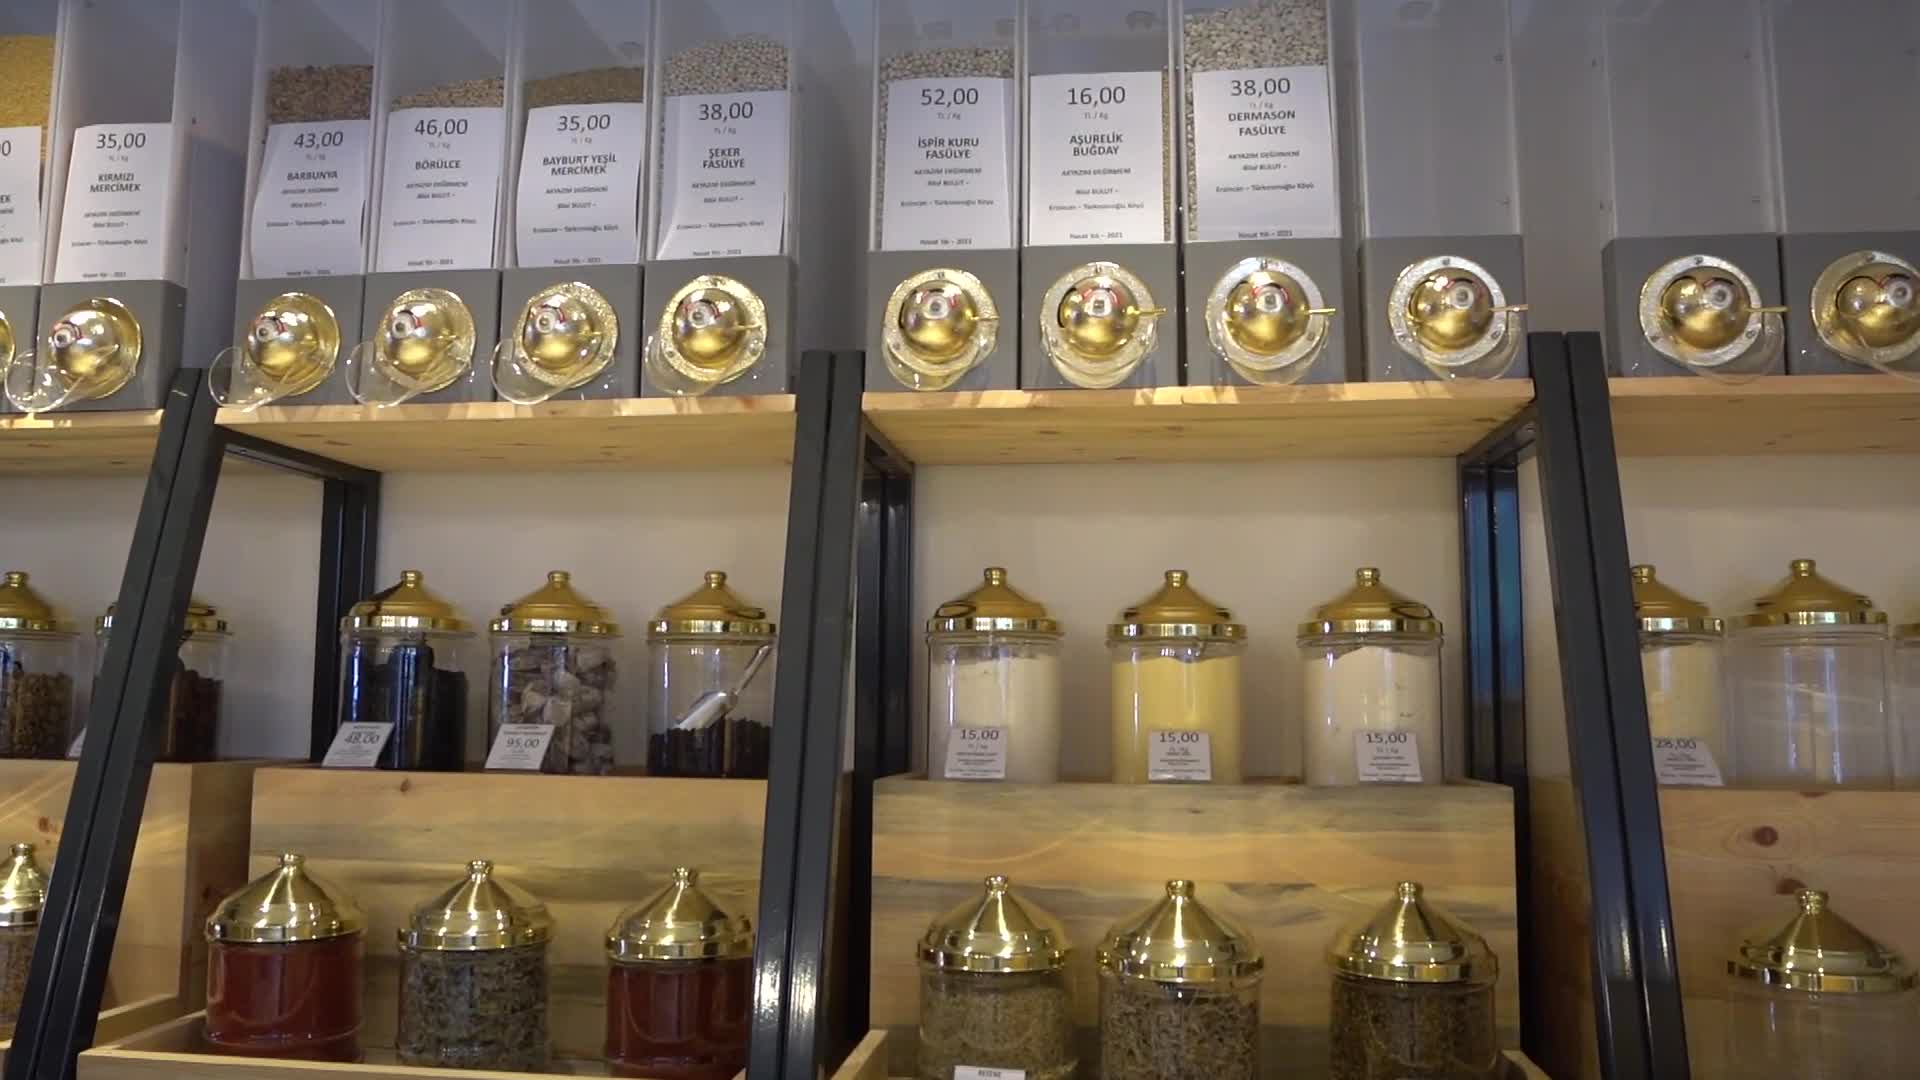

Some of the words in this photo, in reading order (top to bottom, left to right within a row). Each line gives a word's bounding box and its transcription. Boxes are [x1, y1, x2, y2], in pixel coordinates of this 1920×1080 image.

[1231, 78, 1291, 97] 38,00
[921, 87, 979, 108] 52,00
[1068, 86, 1126, 108] 16,00
[699, 101, 754, 122] 38,00
[1228, 110, 1296, 122] DERMASON
[414, 119, 468, 137] 46,00
[557, 114, 611, 133] 35,00
[1239, 124, 1287, 136] FASÜLYE
[96, 132, 146, 151] 35,00
[294, 131, 344, 149] 43,00
[918, 136, 945, 148] İSPİR
[948, 137, 979, 147] KURU
[1069, 131, 1124, 147] AŞURELİK
[709, 147, 741, 159] ŞEKER
[926, 148, 971, 159] FASÜLYE
[1073, 145, 1119, 157] BUĞDAY
[415, 160, 461, 170] BÖRÜLCE
[543, 155, 589, 166] BAYBURT
[591, 152, 617, 164] YEŞİL
[703, 158, 745, 169] FASÜLYE
[287, 171, 338, 181] BARBUNYA
[551, 165, 607, 176] MERCİMEK
[98, 173, 134, 182] KIRMIZI
[89, 183, 141, 192] MERCİMEK
[960, 729, 999, 741] 15,00
[1160, 732, 1199, 744] 15,00
[1365, 732, 1407, 745] 15,00
